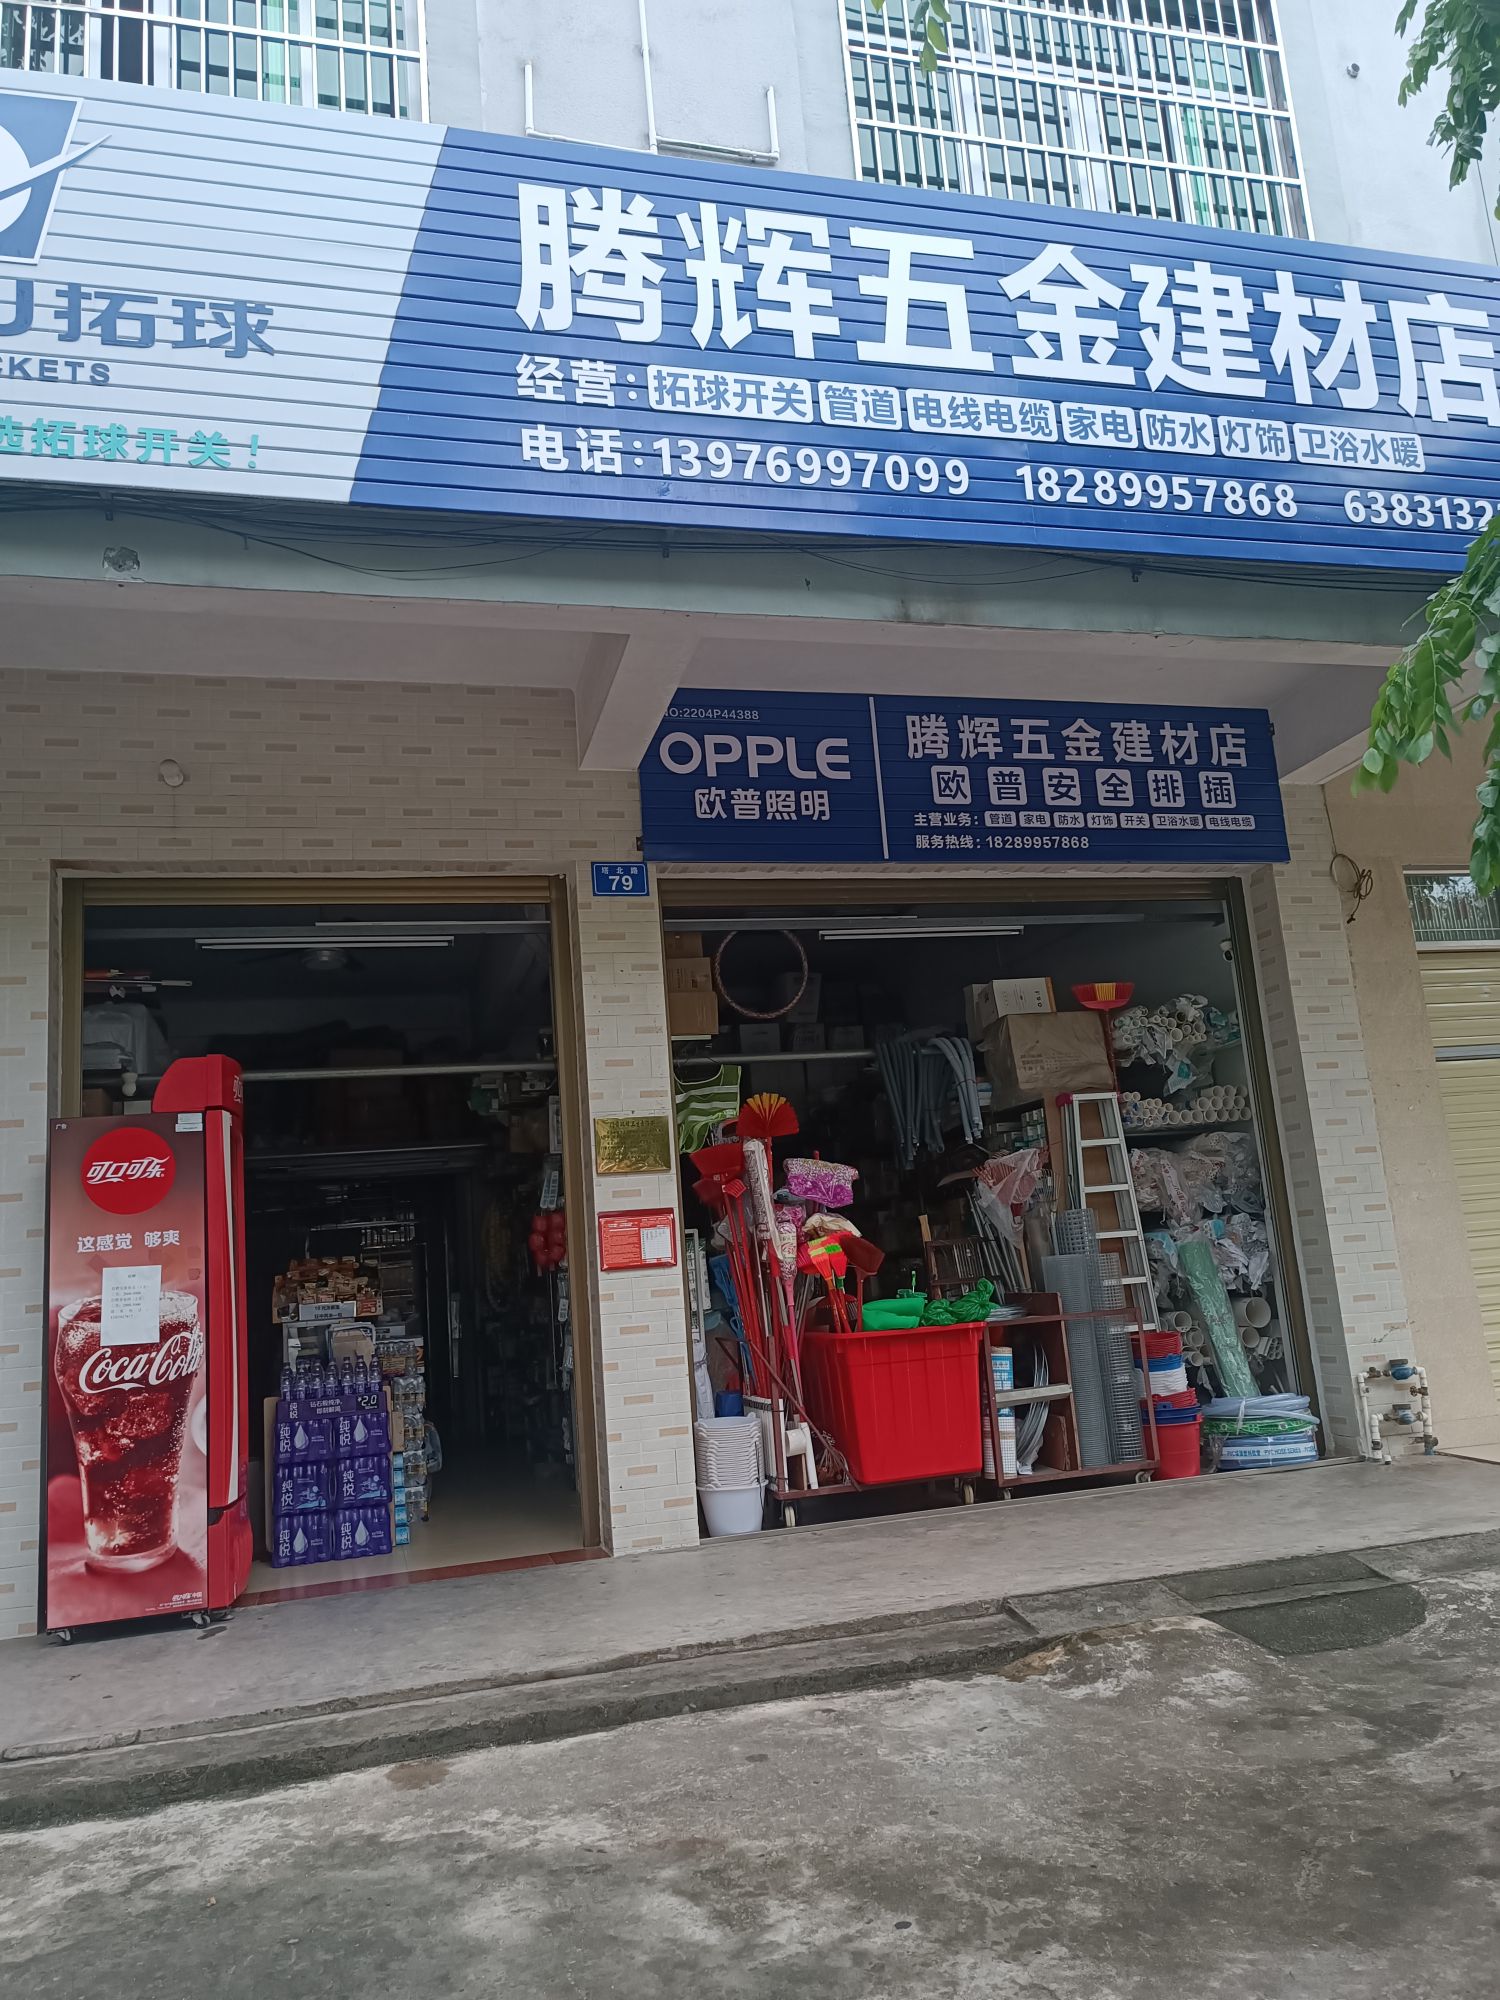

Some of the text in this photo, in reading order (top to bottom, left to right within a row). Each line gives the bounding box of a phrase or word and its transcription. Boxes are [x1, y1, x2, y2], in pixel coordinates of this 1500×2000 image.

[515, 182, 1500, 427] 腾辉五金建材店
[0, 356, 110, 385] KETS
[654, 370, 806, 418] 拓球开关
[824, 385, 897, 426] 管道
[911, 394, 1053, 438] 电线电缆
[1066, 407, 1133, 442] 家电
[1146, 414, 1211, 450] 防水
[1222, 421, 1287, 457] 灯饰
[1299, 429, 1421, 469] 卫浴水暖
[1016, 465, 1298, 517] 18289957868
[1344, 490, 1500, 532] 6383132
[905, 714, 1248, 767] 腾辉五金建材店
[659, 731, 851, 780] OPPLE
[694, 787, 831, 821] 欧普照明
[989, 813, 1013, 825] 管道
[1023, 814, 1047, 826] 家电
[1058, 814, 1081, 826] 防水
[1091, 814, 1114, 826] 灯饰
[1124, 815, 1146, 826] 开关
[1156, 815, 1201, 828] 卫浴水暖
[1209, 816, 1253, 828] 电线电缆
[608, 875, 633, 891] 79
[86, 1155, 170, 1185] 可口可乐
[77, 1229, 180, 1253] 这感觉 够爽
[280, 1426, 291, 1452] 纯悦
[339, 1420, 351, 1446] 纯悦
[281, 1480, 294, 1506] 纯悦
[343, 1469, 356, 1496] 纯悦
[279, 1530, 291, 1556] 纯悦
[341, 1522, 353, 1549] 纯悦
